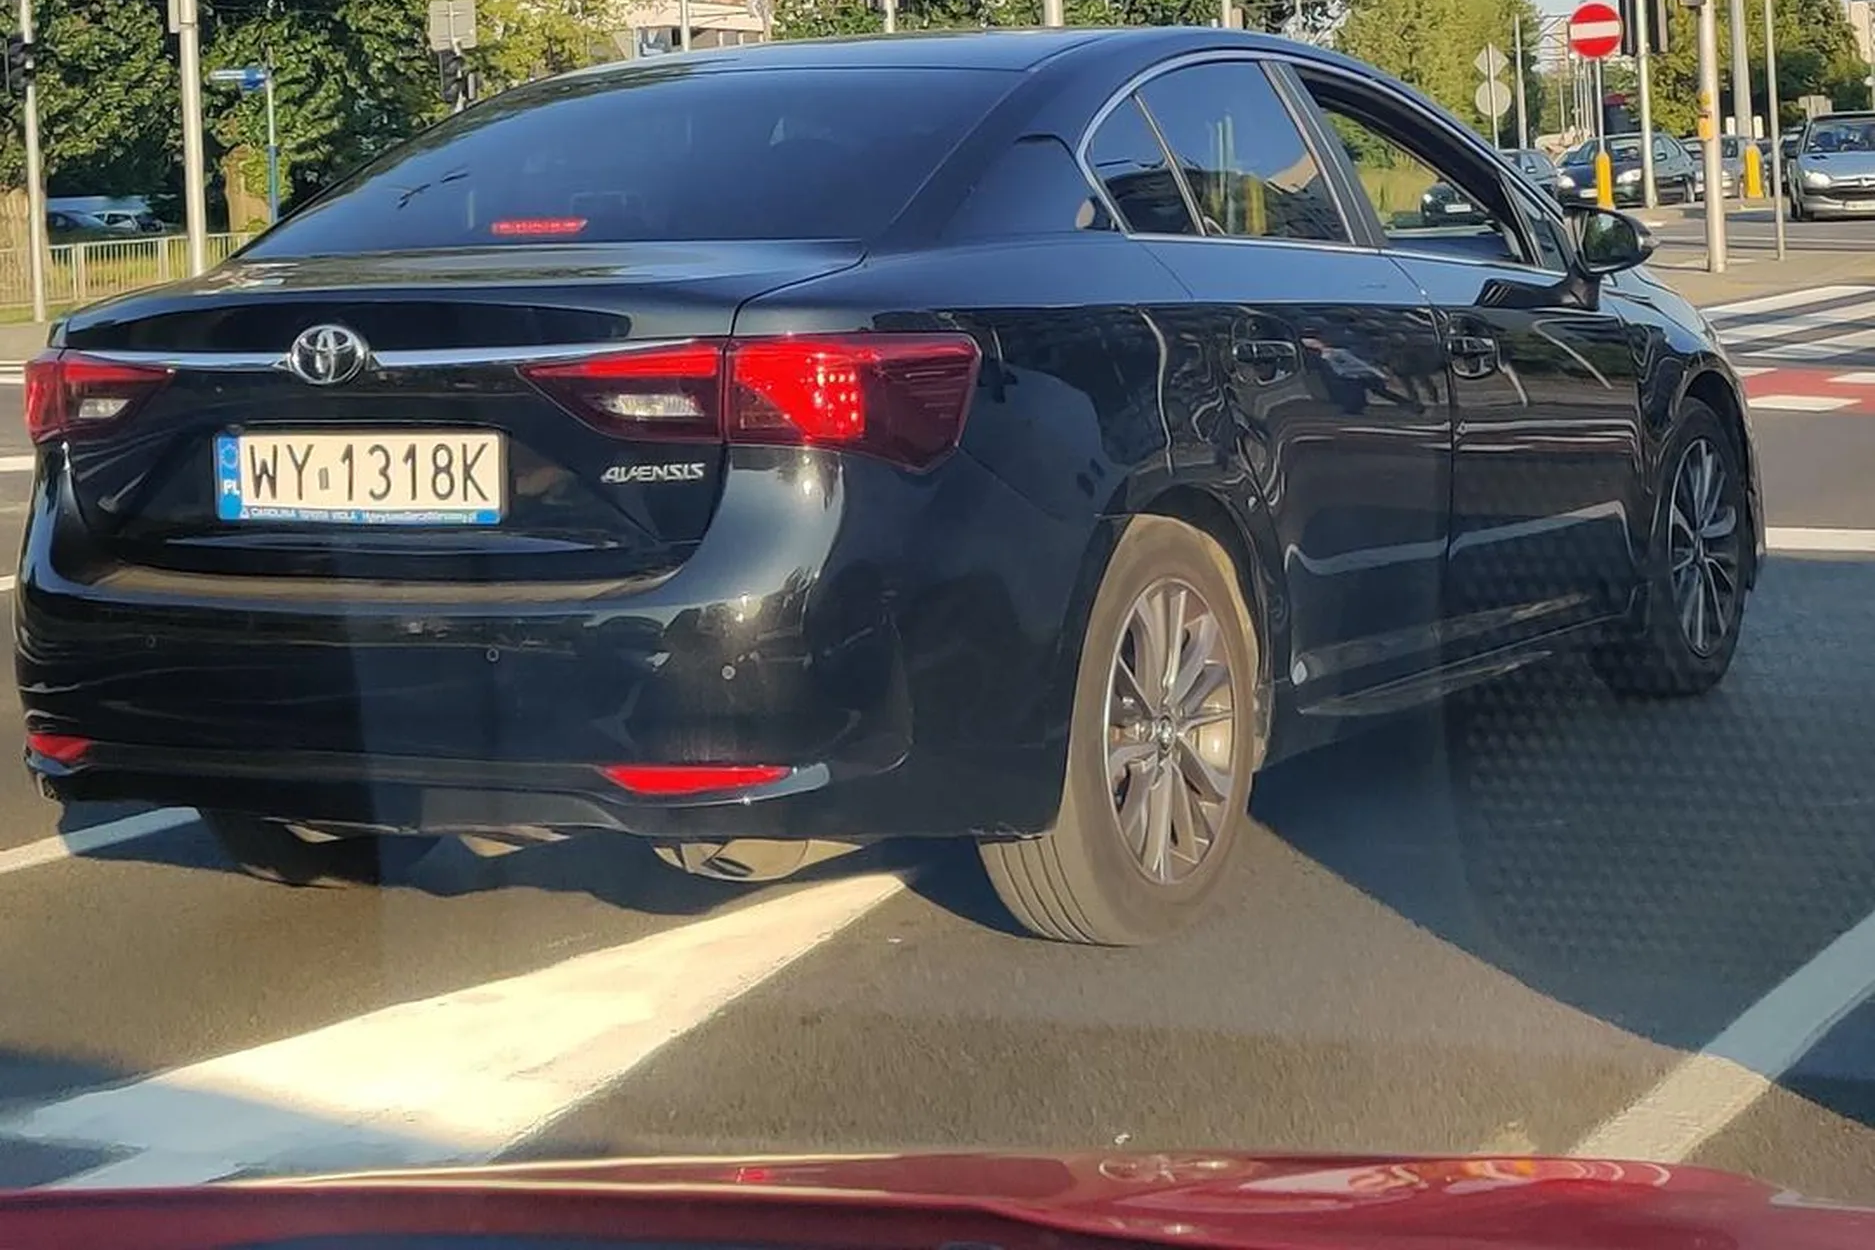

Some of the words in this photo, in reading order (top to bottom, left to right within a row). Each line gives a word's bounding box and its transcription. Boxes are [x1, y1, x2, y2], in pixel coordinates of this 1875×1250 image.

[250, 443, 314, 501] WY
[340, 443, 490, 502] 1318K
[600, 462, 706, 483] AVENSIS
[223, 479, 240, 495] PL
